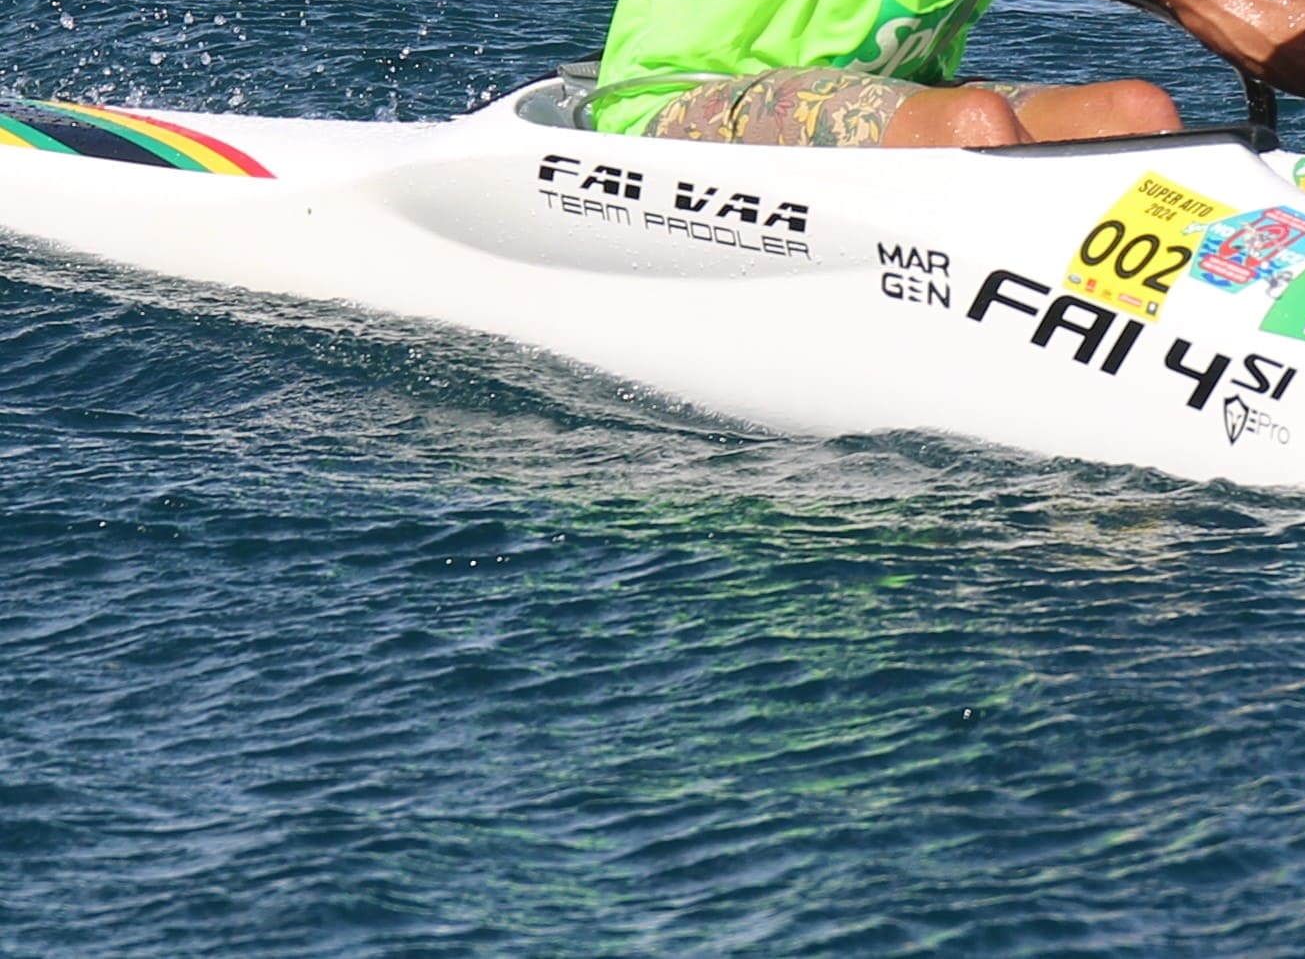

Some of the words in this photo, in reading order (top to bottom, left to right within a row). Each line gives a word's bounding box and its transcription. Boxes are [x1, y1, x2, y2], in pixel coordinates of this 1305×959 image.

[538, 154, 643, 201] FAI
[674, 181, 809, 233] VAA
[1138, 179, 1184, 207] SUPER
[1177, 198, 1214, 218] AITO
[1143, 202, 1178, 222] 2024
[538, 189, 632, 226] TEAM
[643, 211, 812, 261] PADDLER
[877, 242, 950, 277] MAR
[1080, 220, 1193, 294] 002
[881, 272, 951, 310] GEN
[966, 269, 1145, 376] FAI
